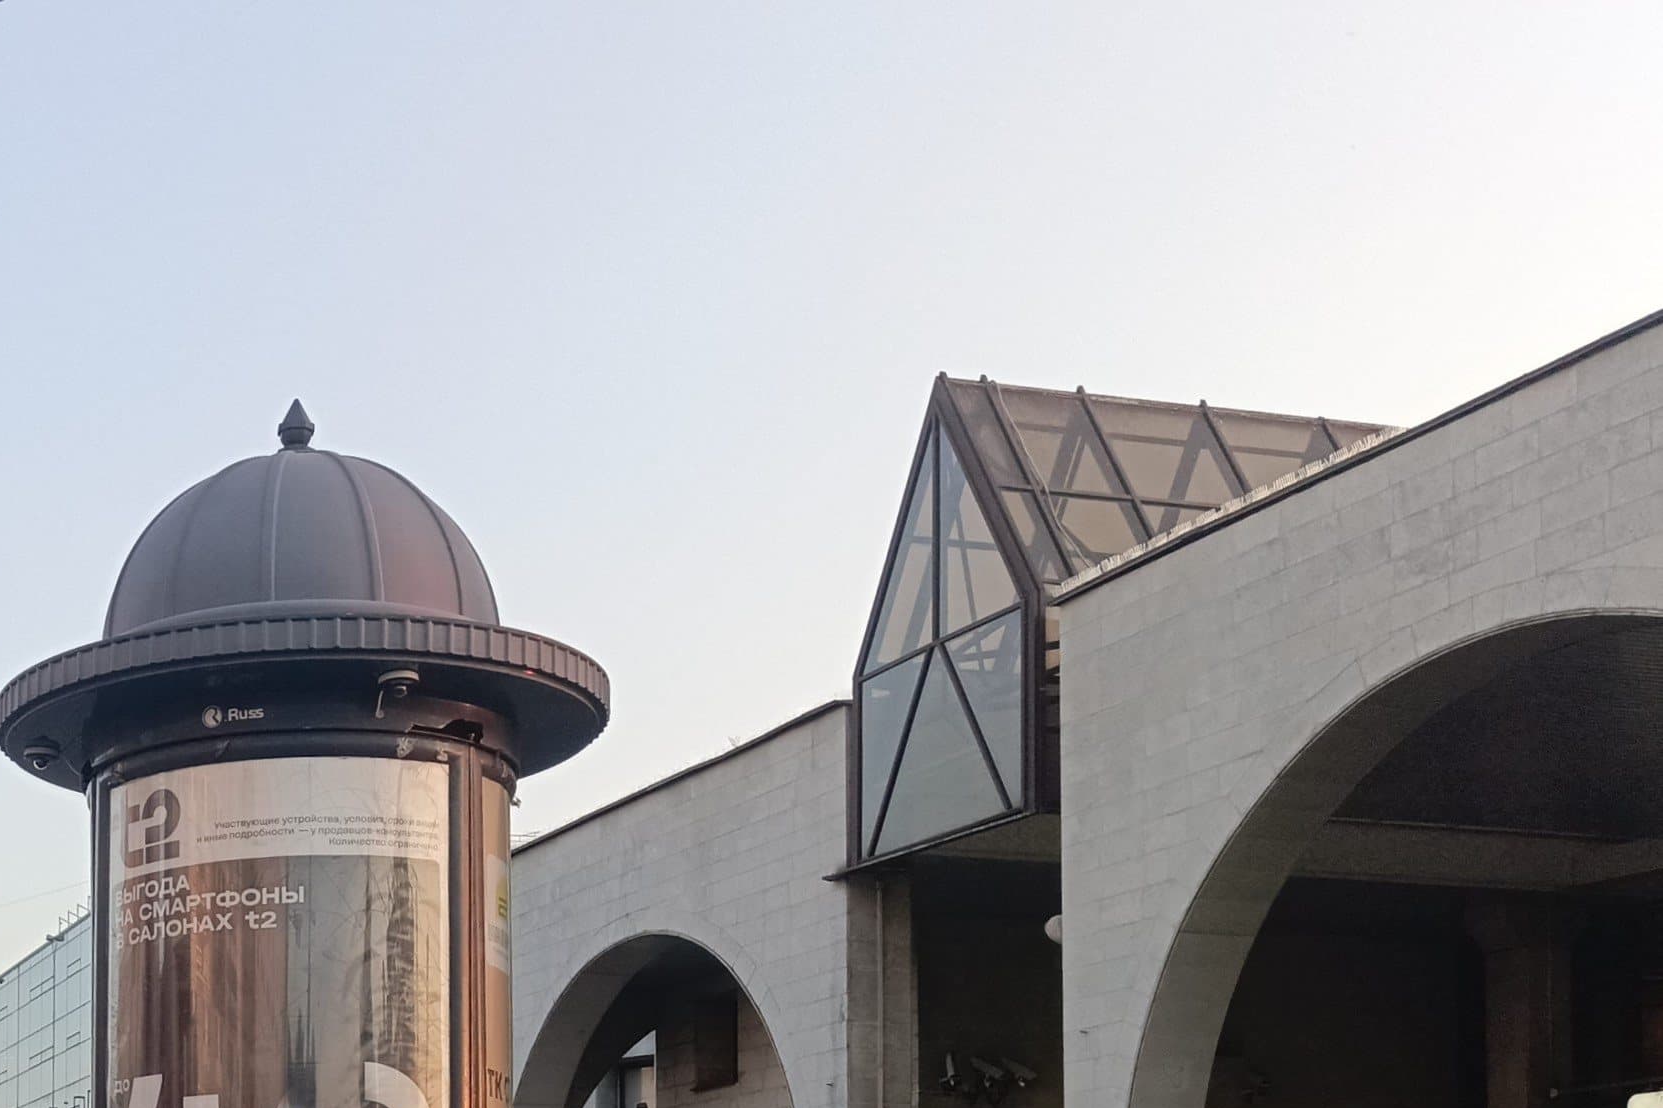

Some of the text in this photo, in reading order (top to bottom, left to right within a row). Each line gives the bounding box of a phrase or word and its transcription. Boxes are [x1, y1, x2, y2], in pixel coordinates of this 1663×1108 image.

[227, 707, 265, 722] Russ
[229, 827, 294, 842] подробности
[329, 836, 386, 848] Количество
[115, 874, 190, 908] ВЫГОДА
[114, 886, 305, 929] НА СМАРТФОНЫ
[128, 912, 233, 945] САЛОНАХ
[244, 910, 278, 930] t2
